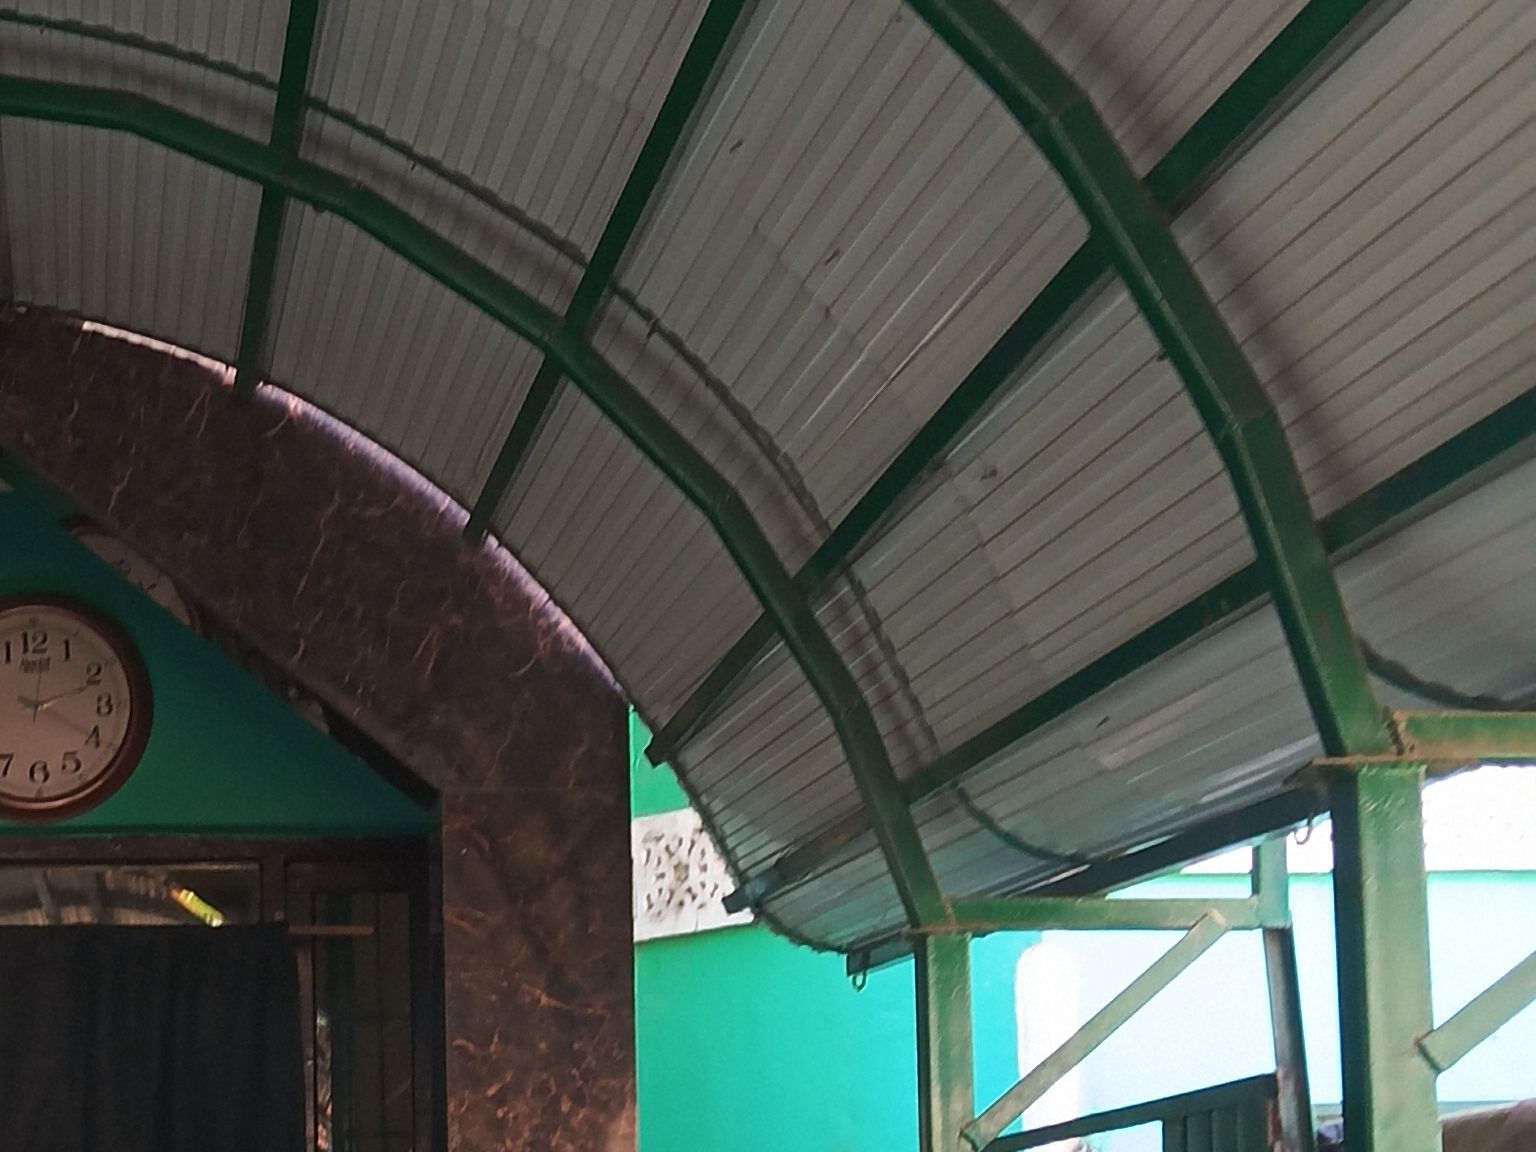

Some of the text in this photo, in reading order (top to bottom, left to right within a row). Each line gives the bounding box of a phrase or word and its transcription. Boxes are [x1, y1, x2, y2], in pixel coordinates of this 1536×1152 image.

[21, 631, 48, 655] 12
[64, 637, 70, 661] 1
[86, 661, 102, 686] 2
[96, 692, 113, 717] 3
[85, 724, 101, 749] 4
[29, 760, 50, 784] 6
[61, 750, 82, 773] 5
